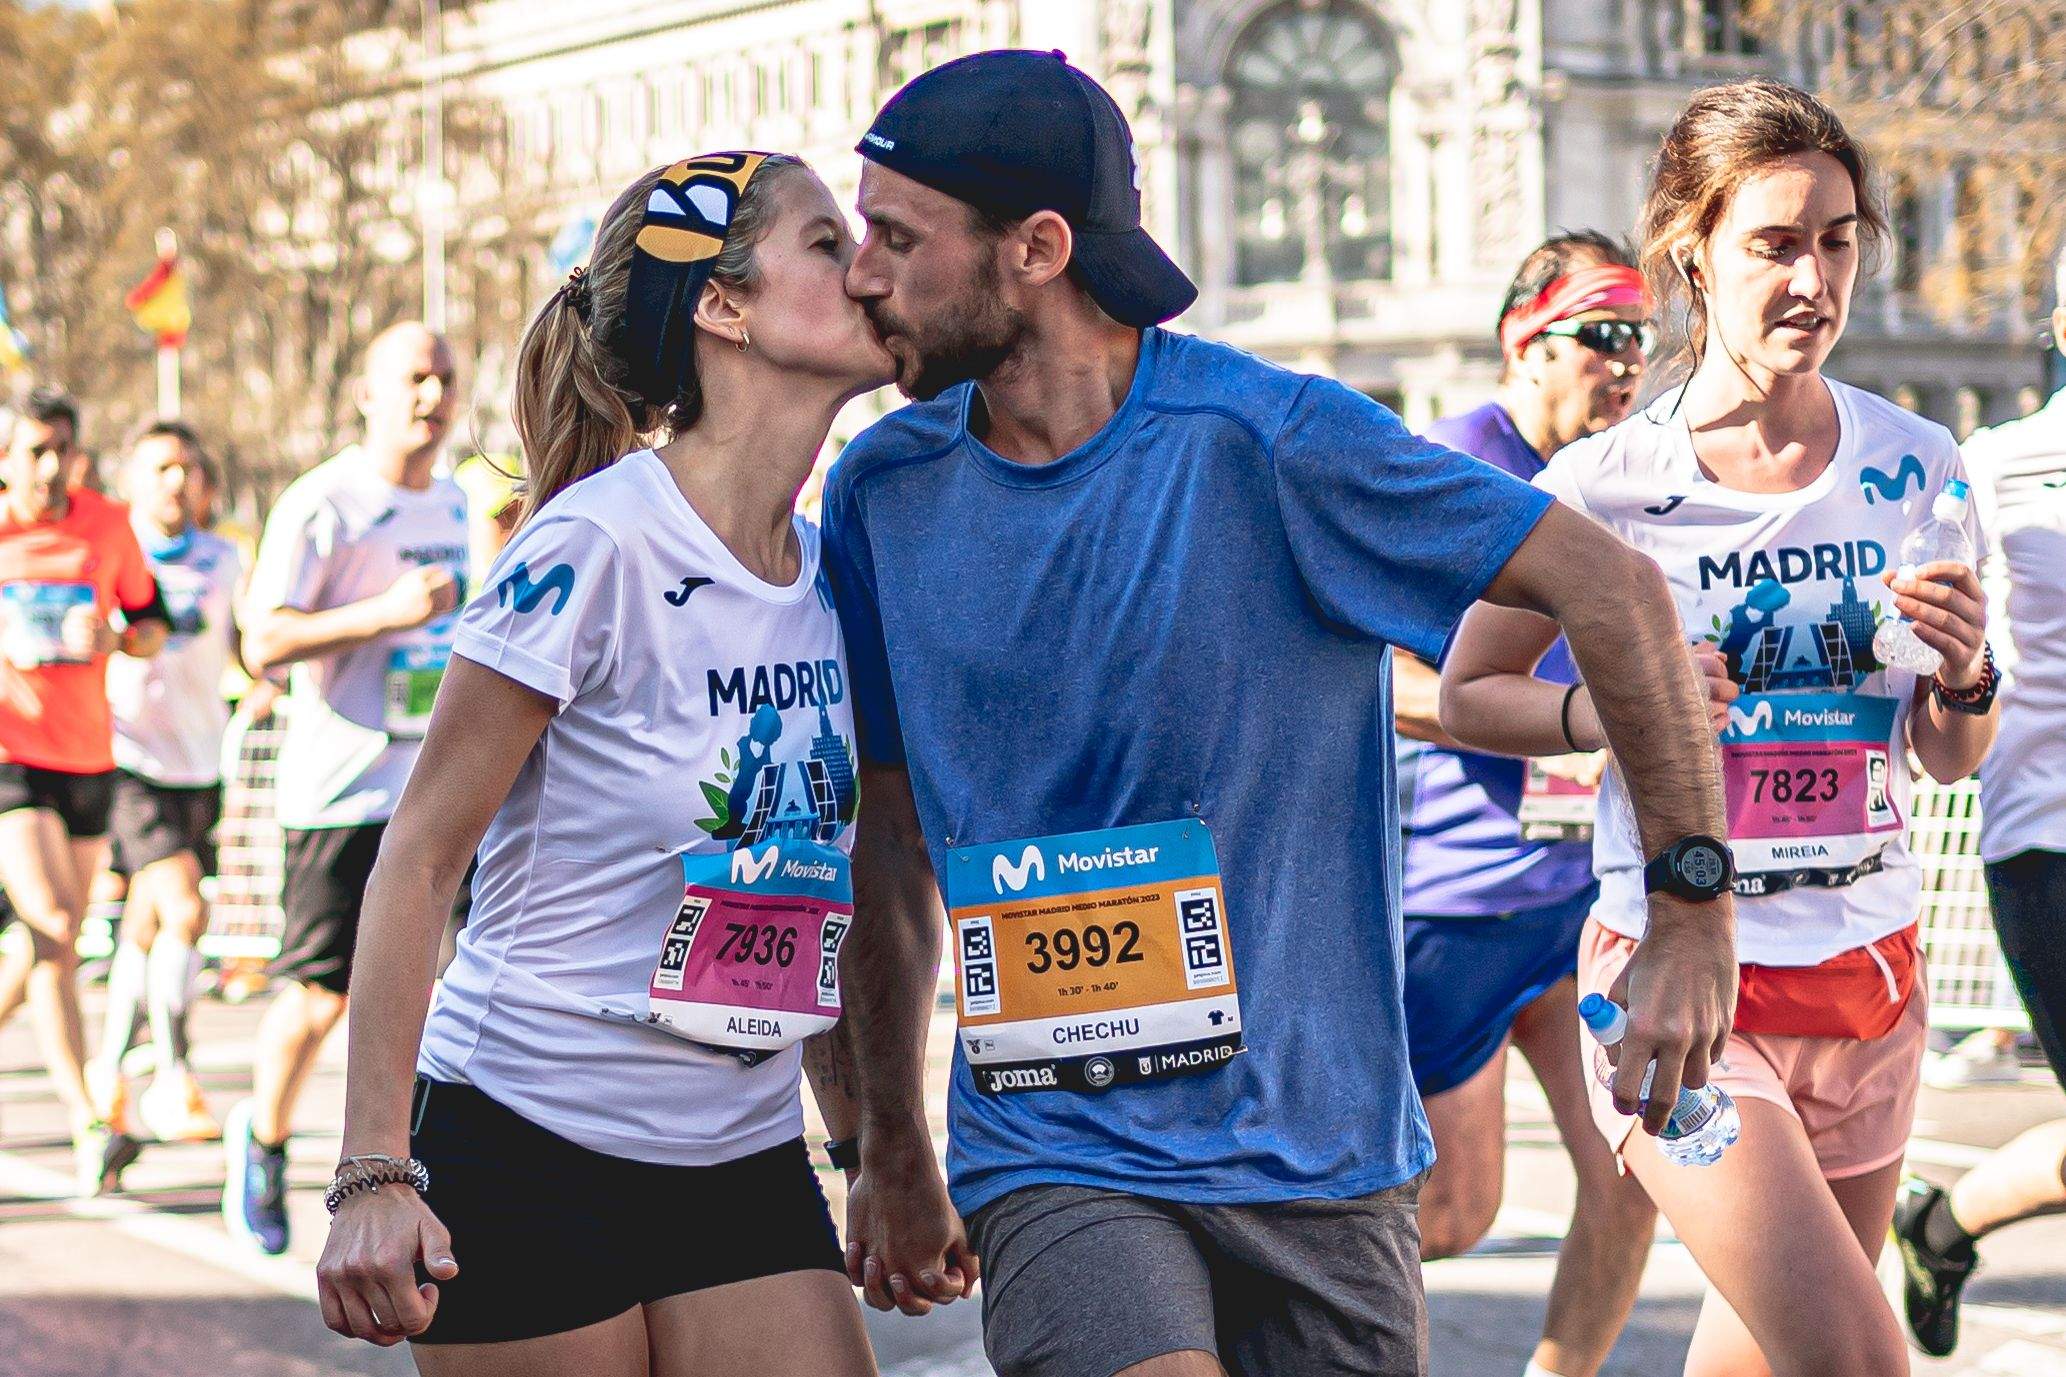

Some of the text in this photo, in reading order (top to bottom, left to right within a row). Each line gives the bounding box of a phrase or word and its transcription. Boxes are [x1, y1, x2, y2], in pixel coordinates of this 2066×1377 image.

[1698, 539, 1887, 591] MADRID
[706, 659, 844, 717] MADRID
[1784, 708, 1856, 727] Movistar
[1750, 767, 1839, 804] 7823
[1057, 845, 1160, 875] Movistar
[1771, 844, 1829, 860] MIREIA
[781, 859, 837, 883] Movistar
[1001, 893, 1161, 920] MOVISTAR MADRID MEDIO MARATÓN 2023
[715, 922, 799, 968] 7936
[1024, 920, 1145, 974] 3992
[1057, 987, 1069, 997] 1h
[1069, 985, 1085, 995] 30'
[1091, 983, 1102, 993] 1h
[1103, 981, 1119, 991] 40'
[726, 1016, 782, 1038] ALEIDA
[1052, 1017, 1141, 1044] CHECHU
[1161, 1045, 1233, 1070] MADRID
